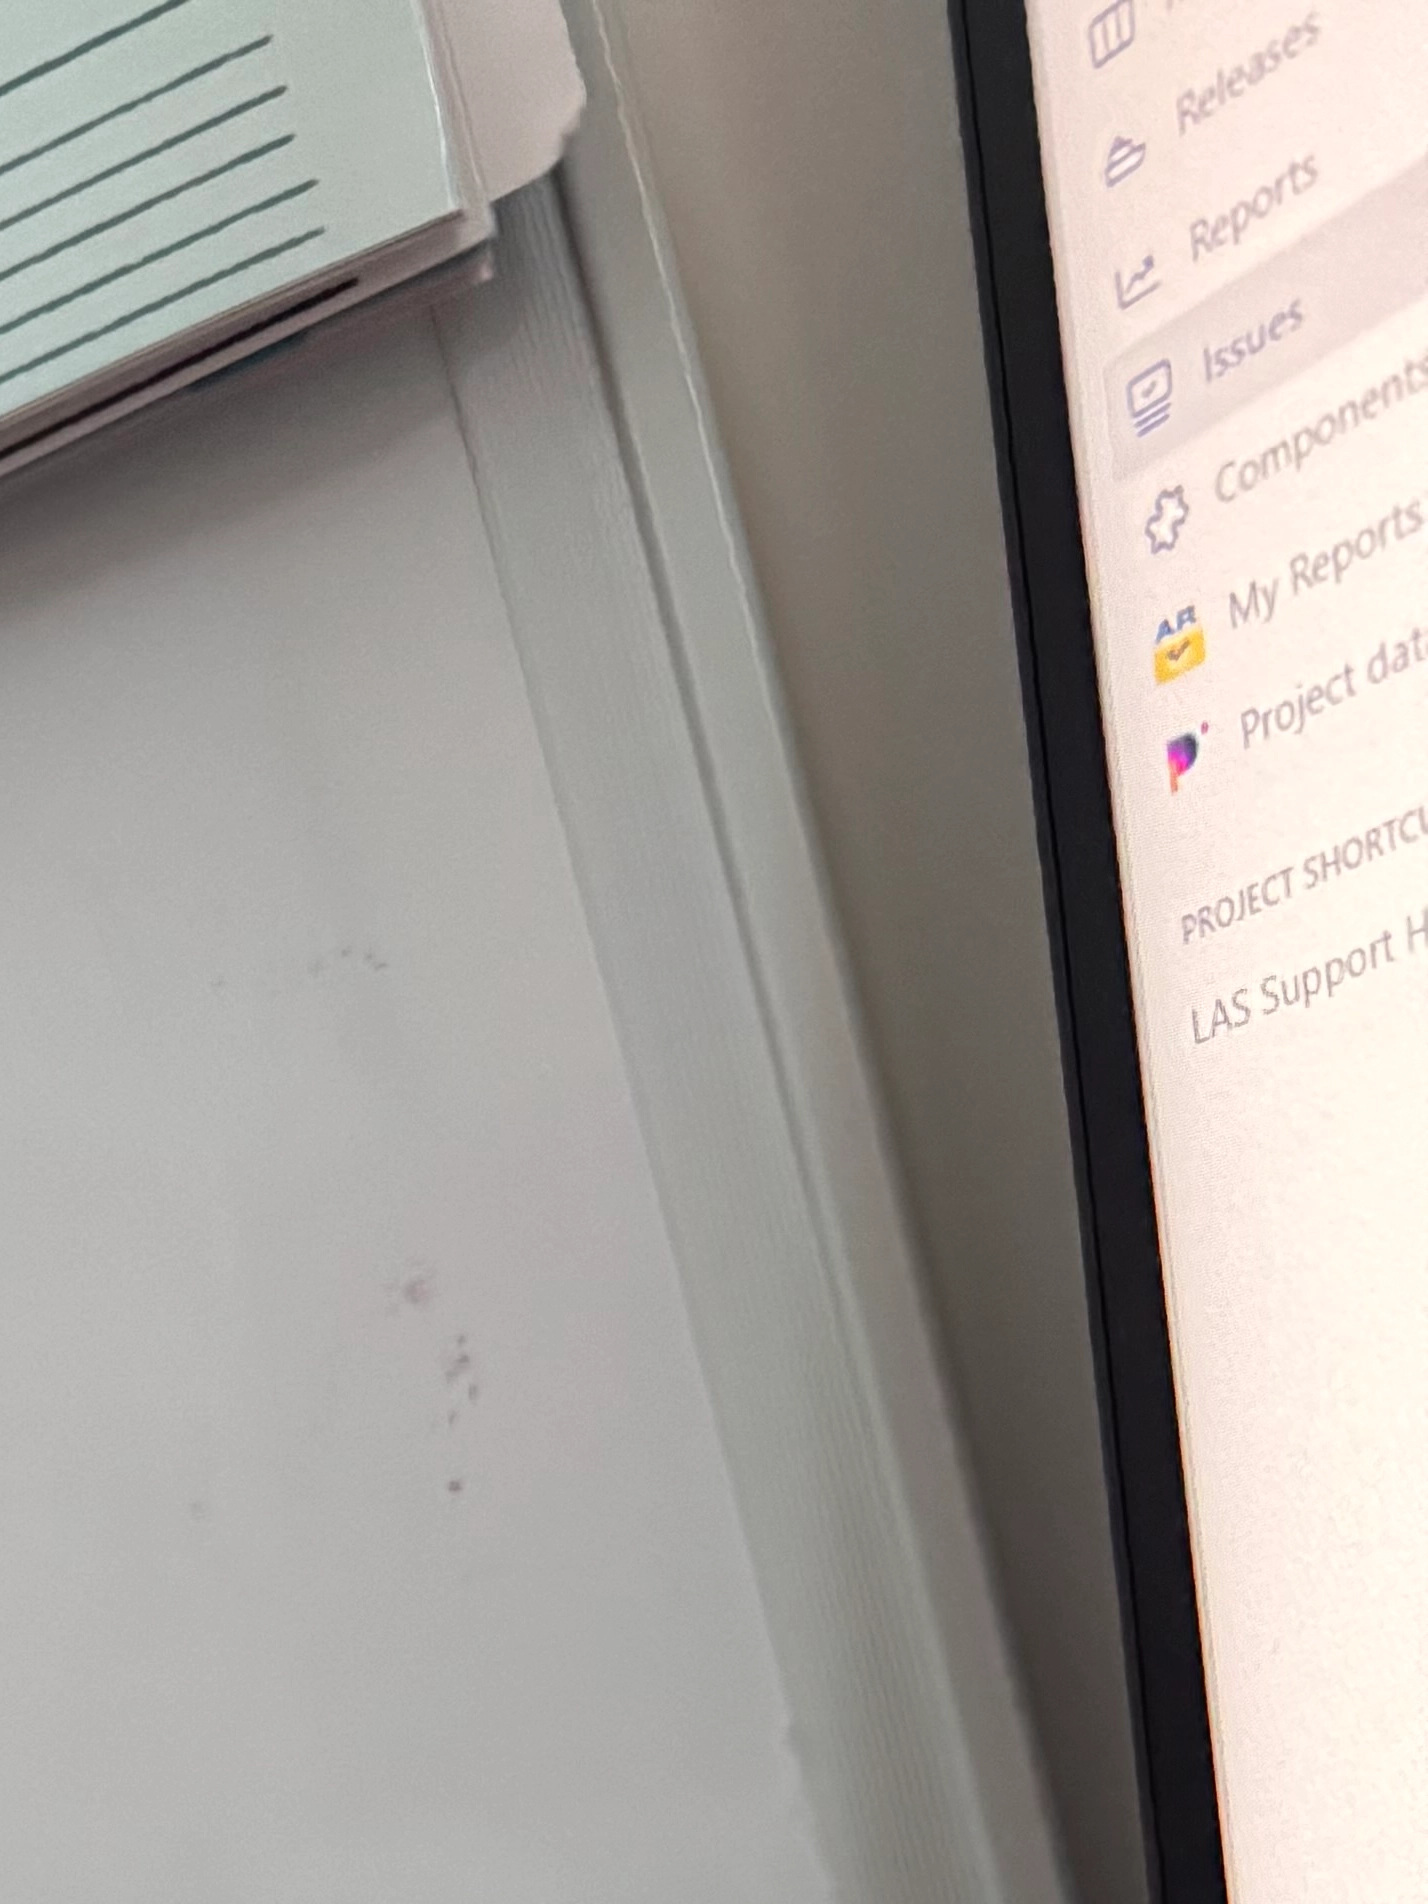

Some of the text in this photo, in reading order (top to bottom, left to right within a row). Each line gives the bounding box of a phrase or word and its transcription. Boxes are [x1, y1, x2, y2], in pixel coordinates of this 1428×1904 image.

[1177, 11, 1322, 137] Releases
[1189, 154, 1319, 263] Reports
[1204, 299, 1305, 383] Issues
[1229, 499, 1425, 629] My Reports
[1240, 626, 1428, 749] Project dat
[1181, 866, 1295, 945] PROJECT
[1191, 987, 1251, 1044] LAS
[1260, 930, 1396, 1015] Support
